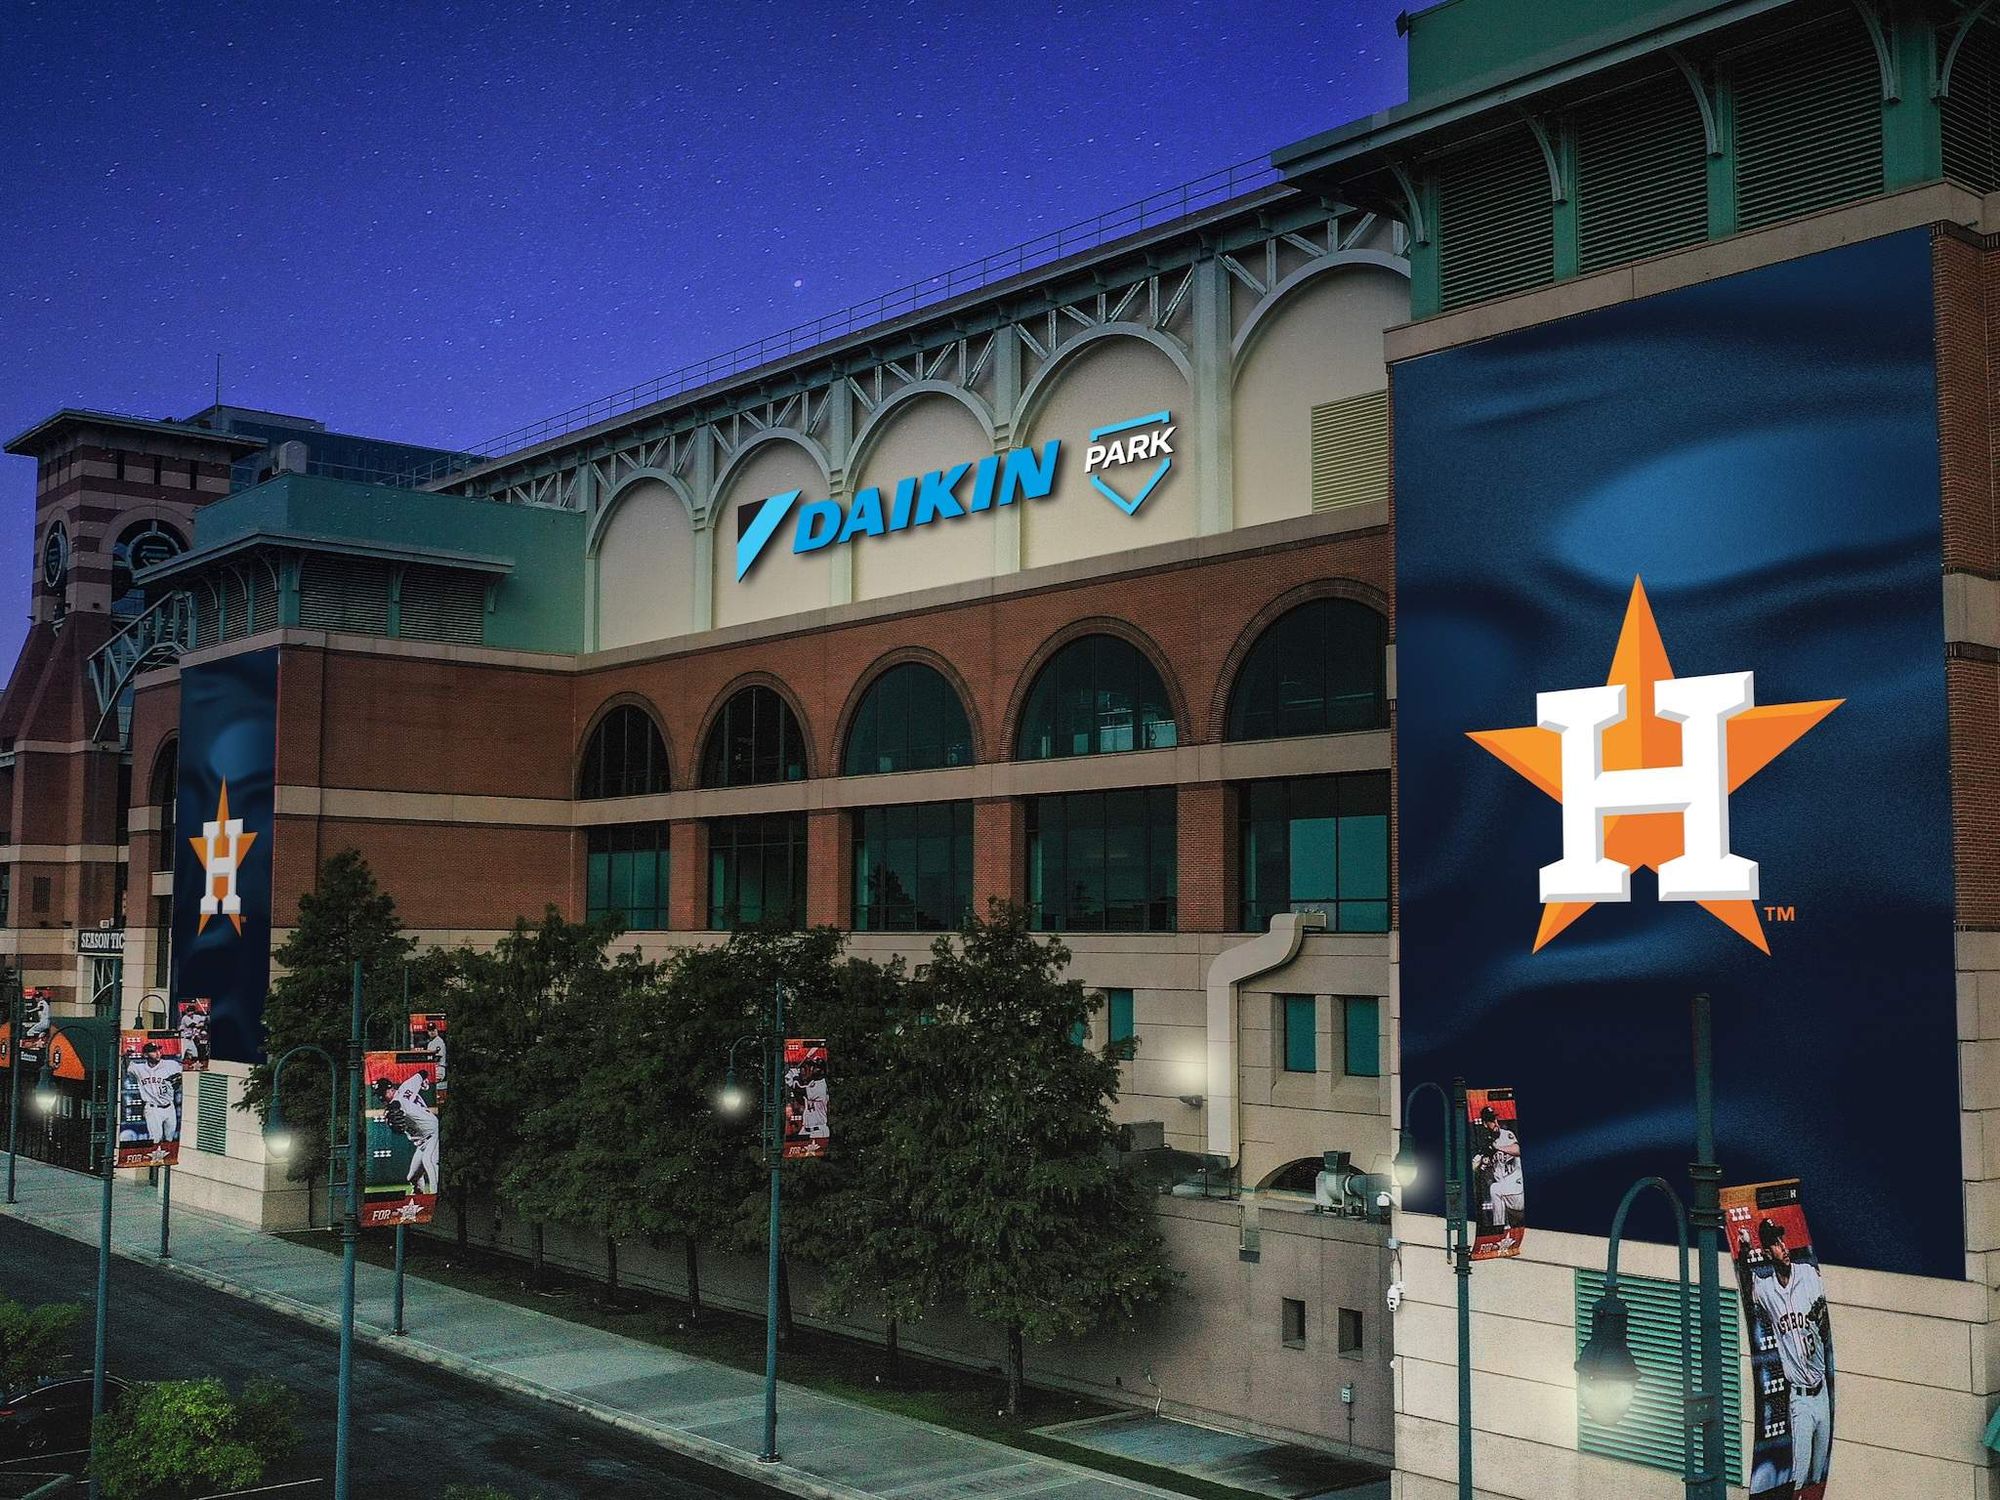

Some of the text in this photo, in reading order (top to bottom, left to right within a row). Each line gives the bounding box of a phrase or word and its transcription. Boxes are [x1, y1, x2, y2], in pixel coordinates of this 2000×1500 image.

[1083, 425, 1177, 475] PARK
[792, 439, 1062, 555] DAIKIN
[1764, 906, 1795, 922] TM
[81, 932, 110, 949] SEASON
[372, 1209, 392, 1221] FOR
